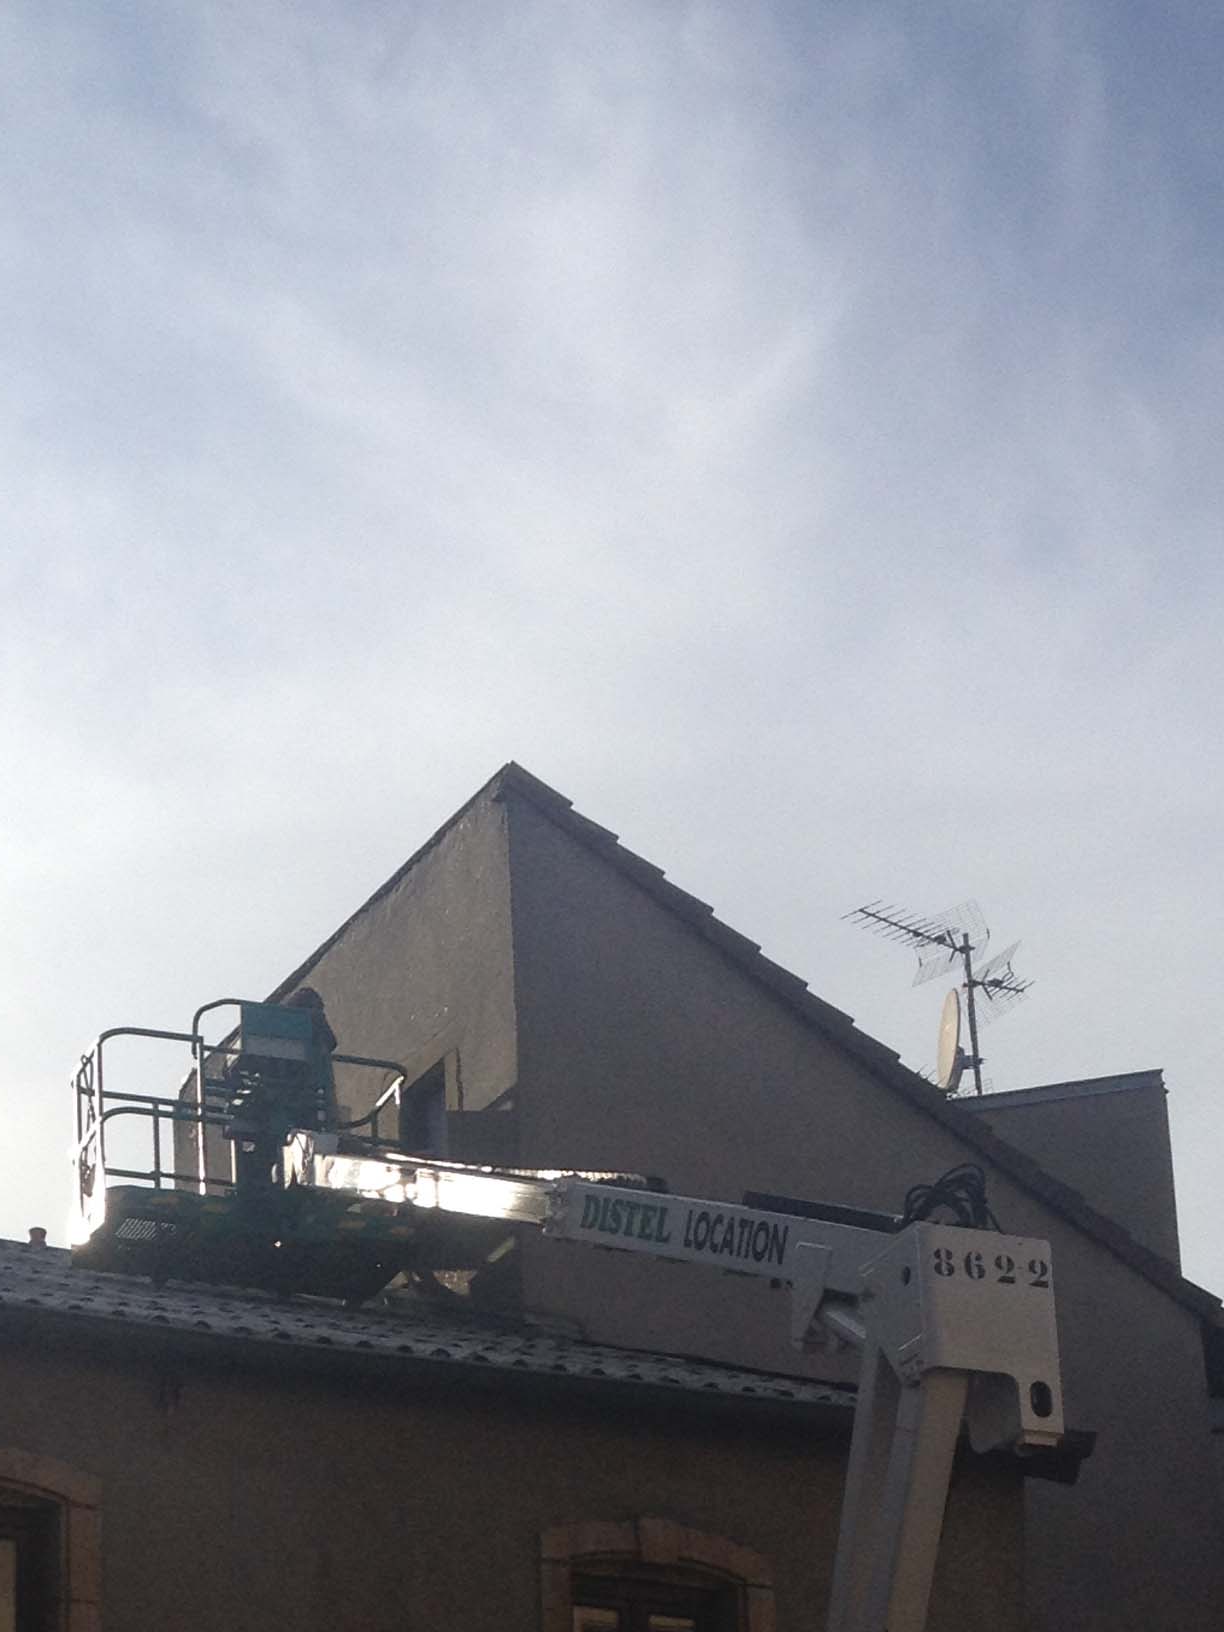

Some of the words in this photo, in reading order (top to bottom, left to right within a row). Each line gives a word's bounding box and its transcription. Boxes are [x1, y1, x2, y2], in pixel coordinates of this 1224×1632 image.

[580, 1194, 672, 1243] DISTEL
[683, 1209, 789, 1265] LOCATION
[933, 1247, 1049, 1288] 8622
